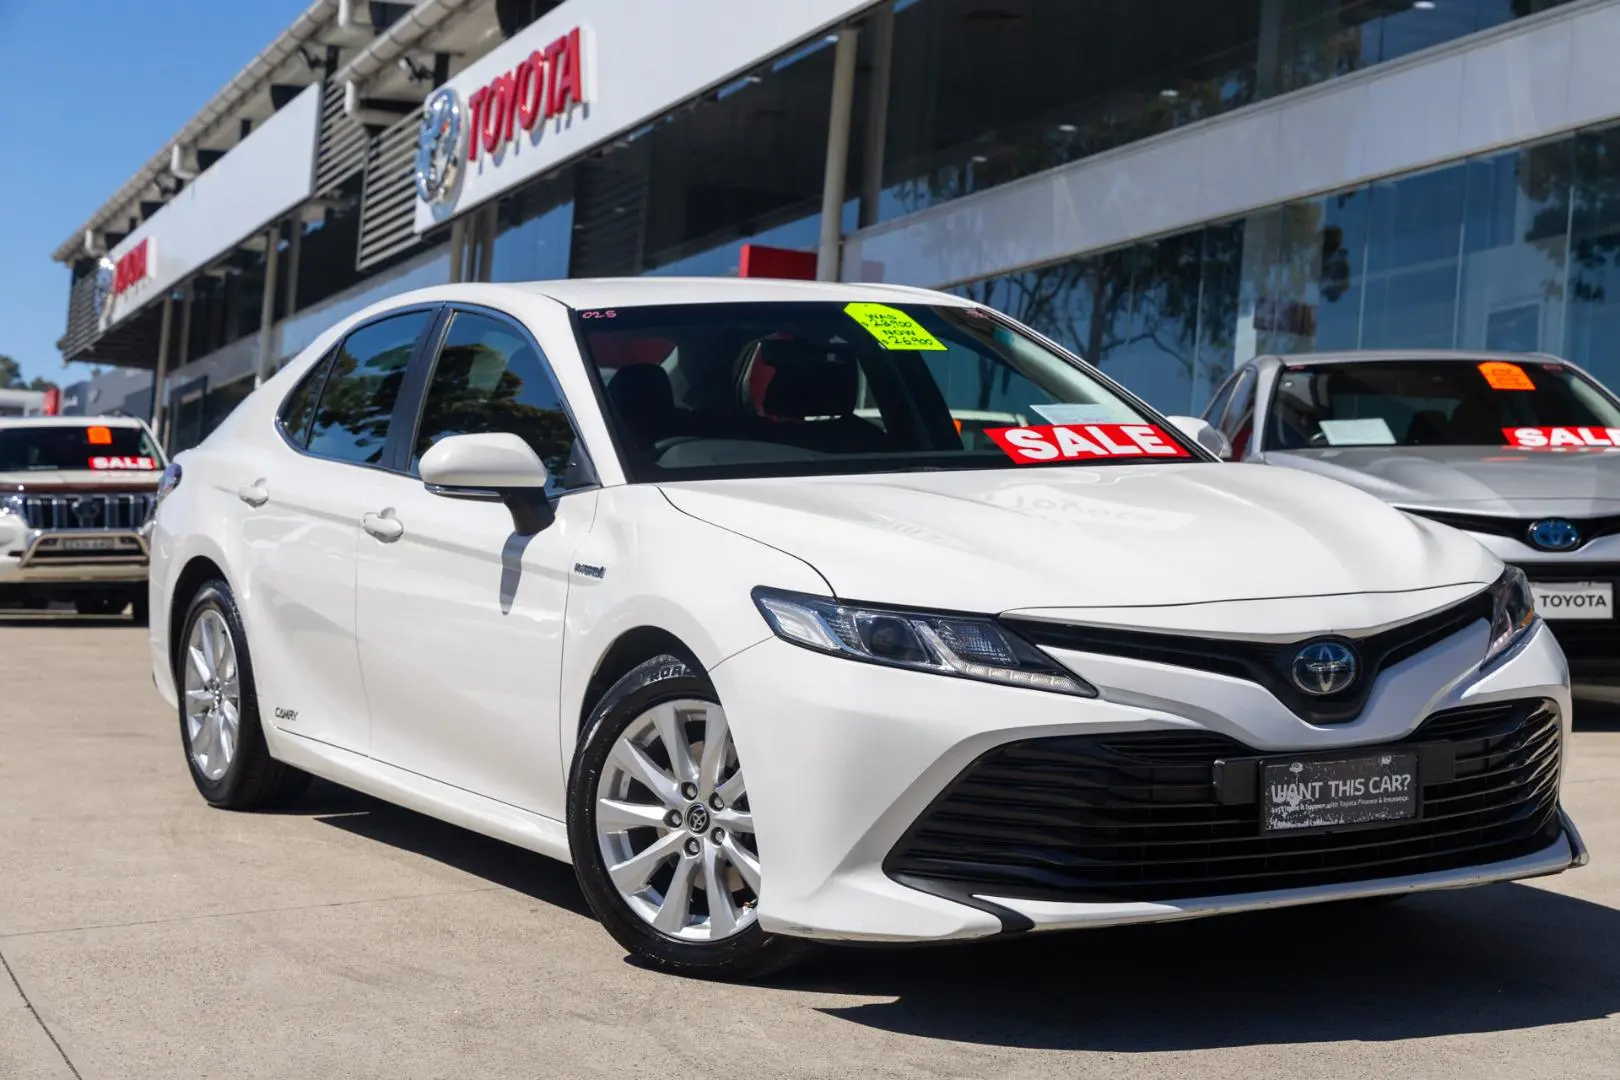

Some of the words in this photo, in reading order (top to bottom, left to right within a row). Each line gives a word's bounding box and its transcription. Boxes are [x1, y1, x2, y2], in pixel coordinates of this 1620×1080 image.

[468, 26, 583, 162] TOYOTA
[1005, 425, 1177, 460] SALE
[94, 456, 152, 469] SALE
[1540, 594, 1607, 608] TOYOTA
[275, 707, 299, 721] CAMRY
[1271, 782, 1323, 803] WANT
[1328, 779, 1365, 798] THIS
[1369, 774, 1411, 794] CAR?
[1340, 799, 1357, 808] Toyota
